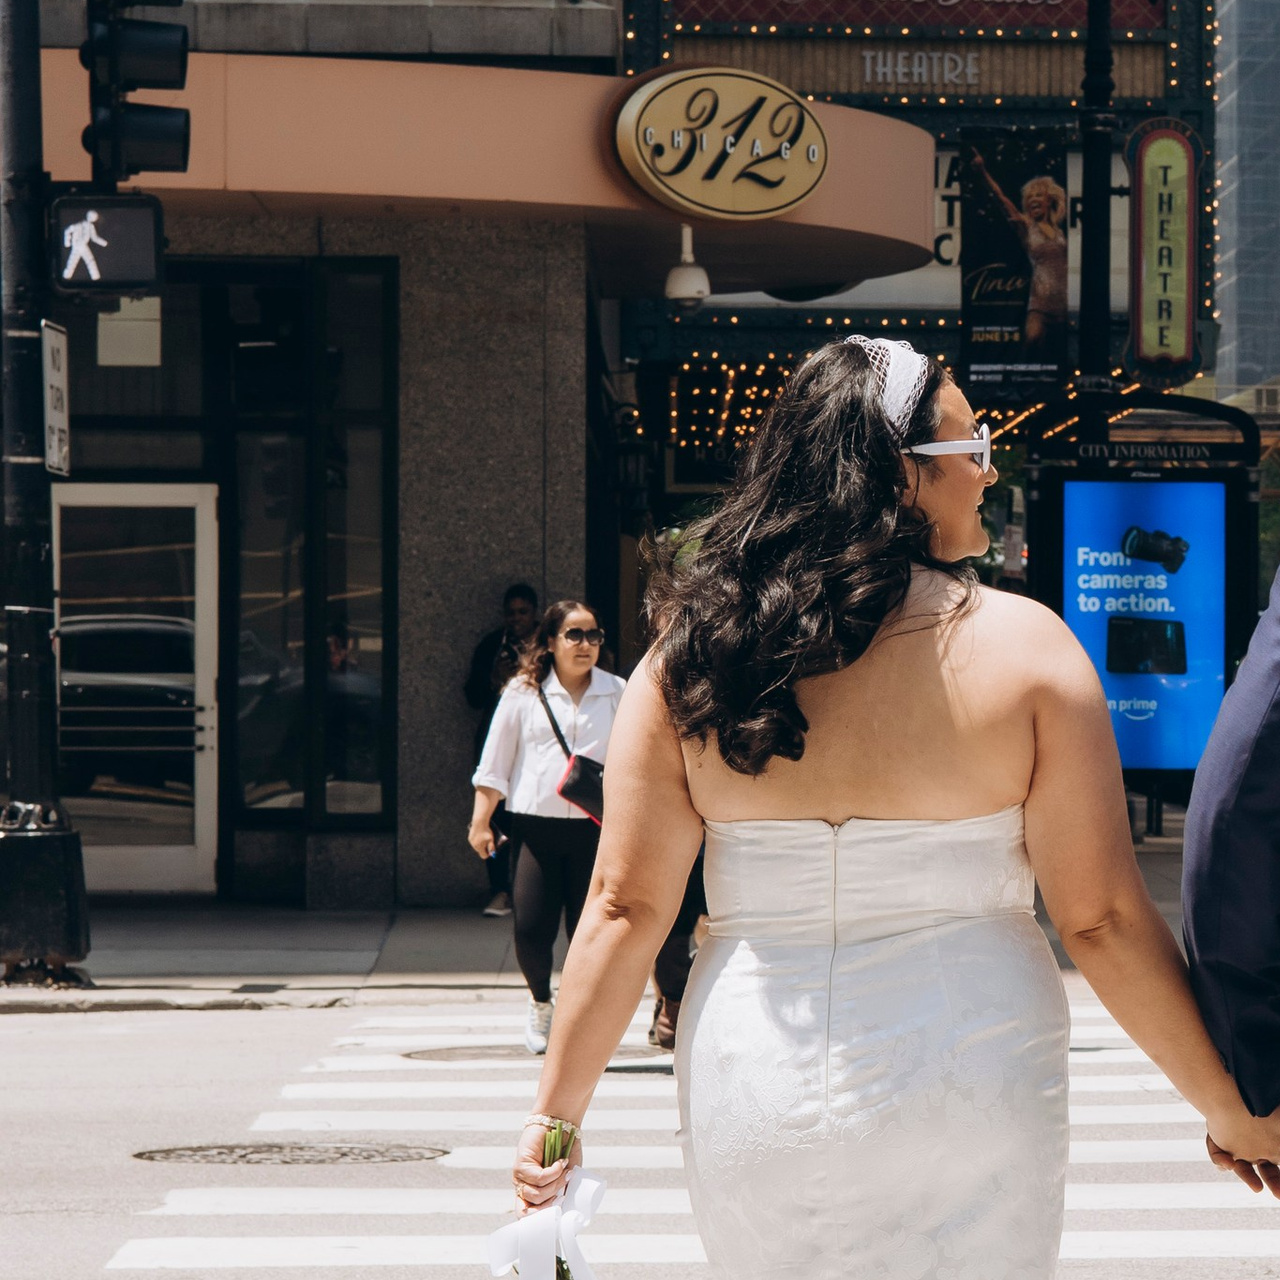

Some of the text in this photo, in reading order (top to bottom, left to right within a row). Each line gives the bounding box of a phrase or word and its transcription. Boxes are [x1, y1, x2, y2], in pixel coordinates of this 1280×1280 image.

[862, 50, 980, 85] THEATRE
[644, 126, 819, 163] CHICAGO
[650, 87, 805, 189] 312
[1157, 165, 1173, 348] THEATRE
[972, 332, 1001, 342] JUNE
[1079, 444, 1211, 459] CITY INFORMATION
[1077, 573, 1168, 589] cameras
[1077, 593, 1176, 612] to action.
[1118, 697, 1158, 713] prime
